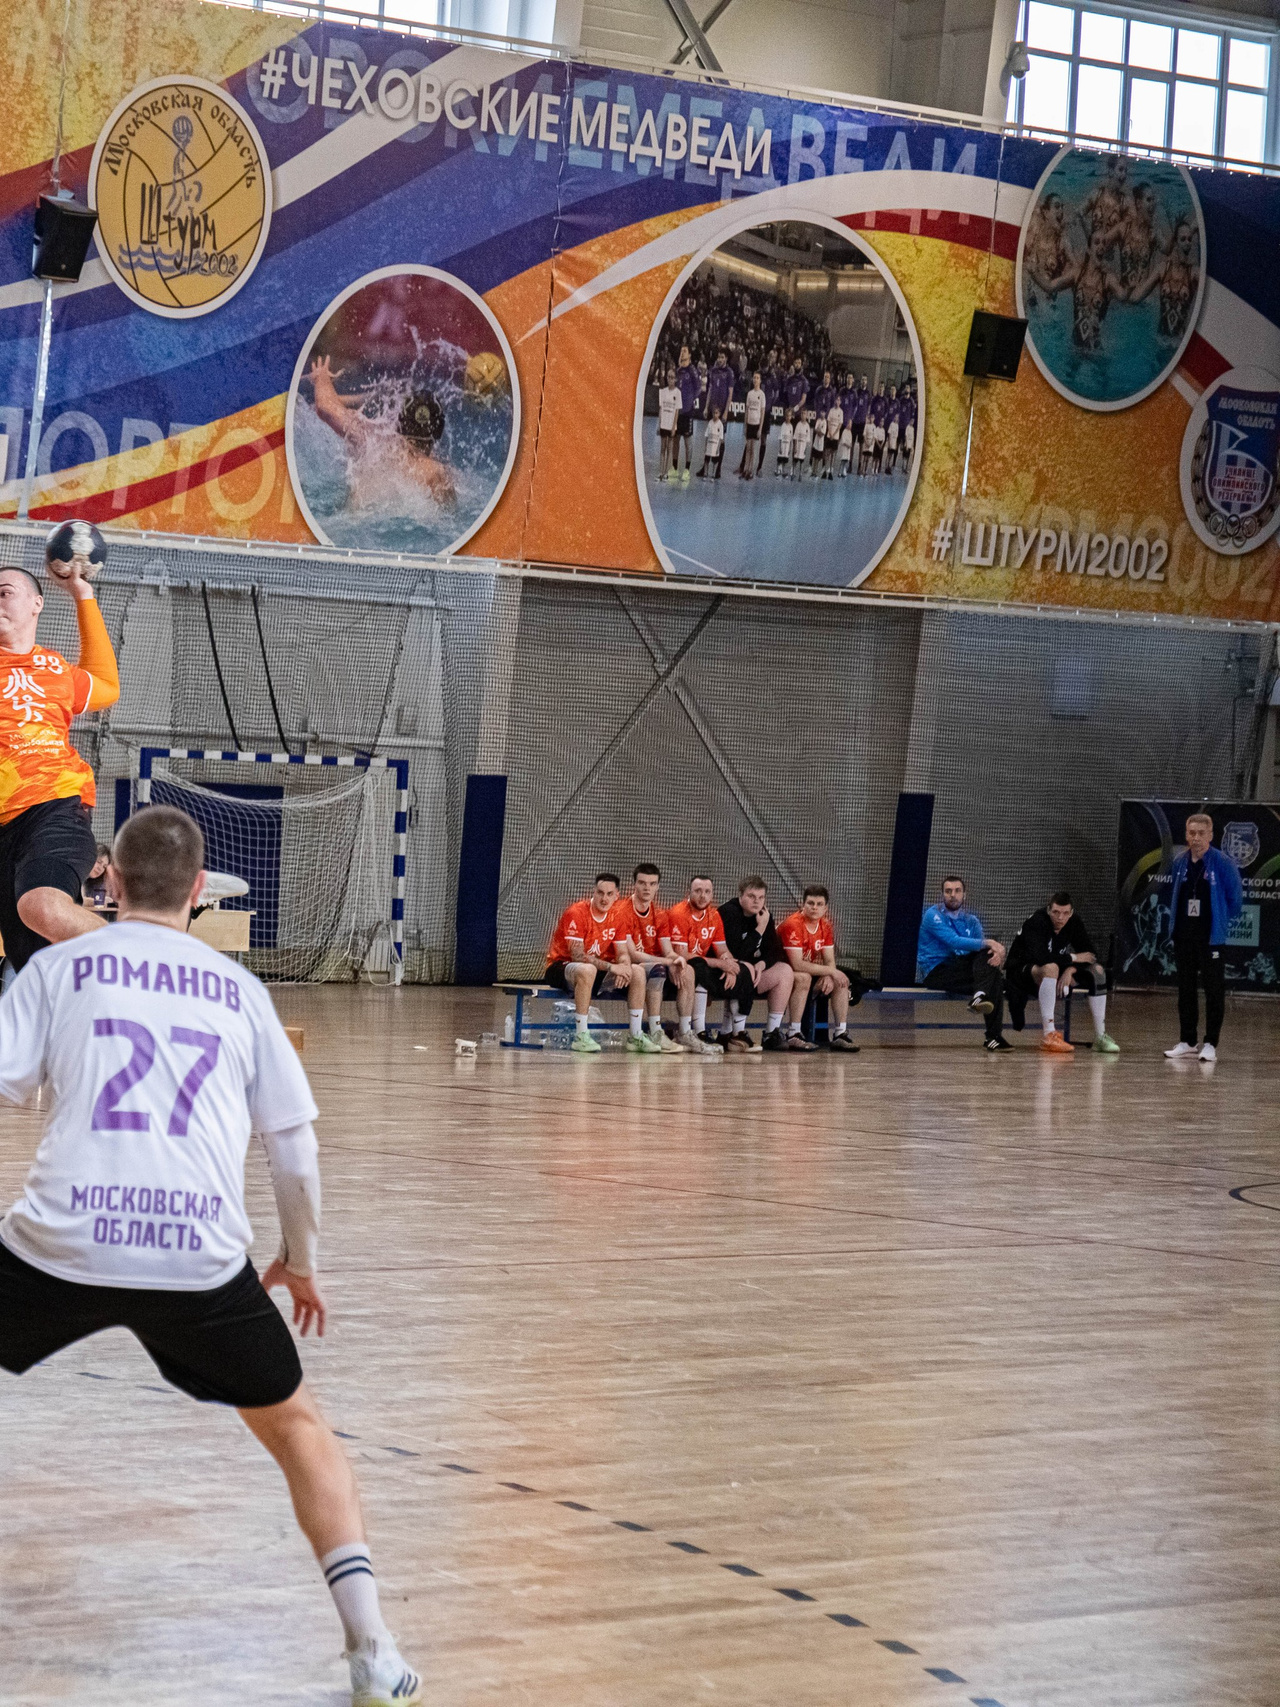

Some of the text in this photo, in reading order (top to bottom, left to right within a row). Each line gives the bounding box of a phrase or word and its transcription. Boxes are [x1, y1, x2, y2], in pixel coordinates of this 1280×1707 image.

[260, 48, 772, 180] #ЧЕХОВСКИЕ МЕДВЕДИ
[701, 926, 716, 940] 97
[72, 954, 241, 1013] РОМАНОВ
[91, 1018, 221, 1138] 27
[70, 1185, 223, 1223] МОСКОВСКАЯ
[94, 1218, 203, 1252] ОБЛАСТЬ
